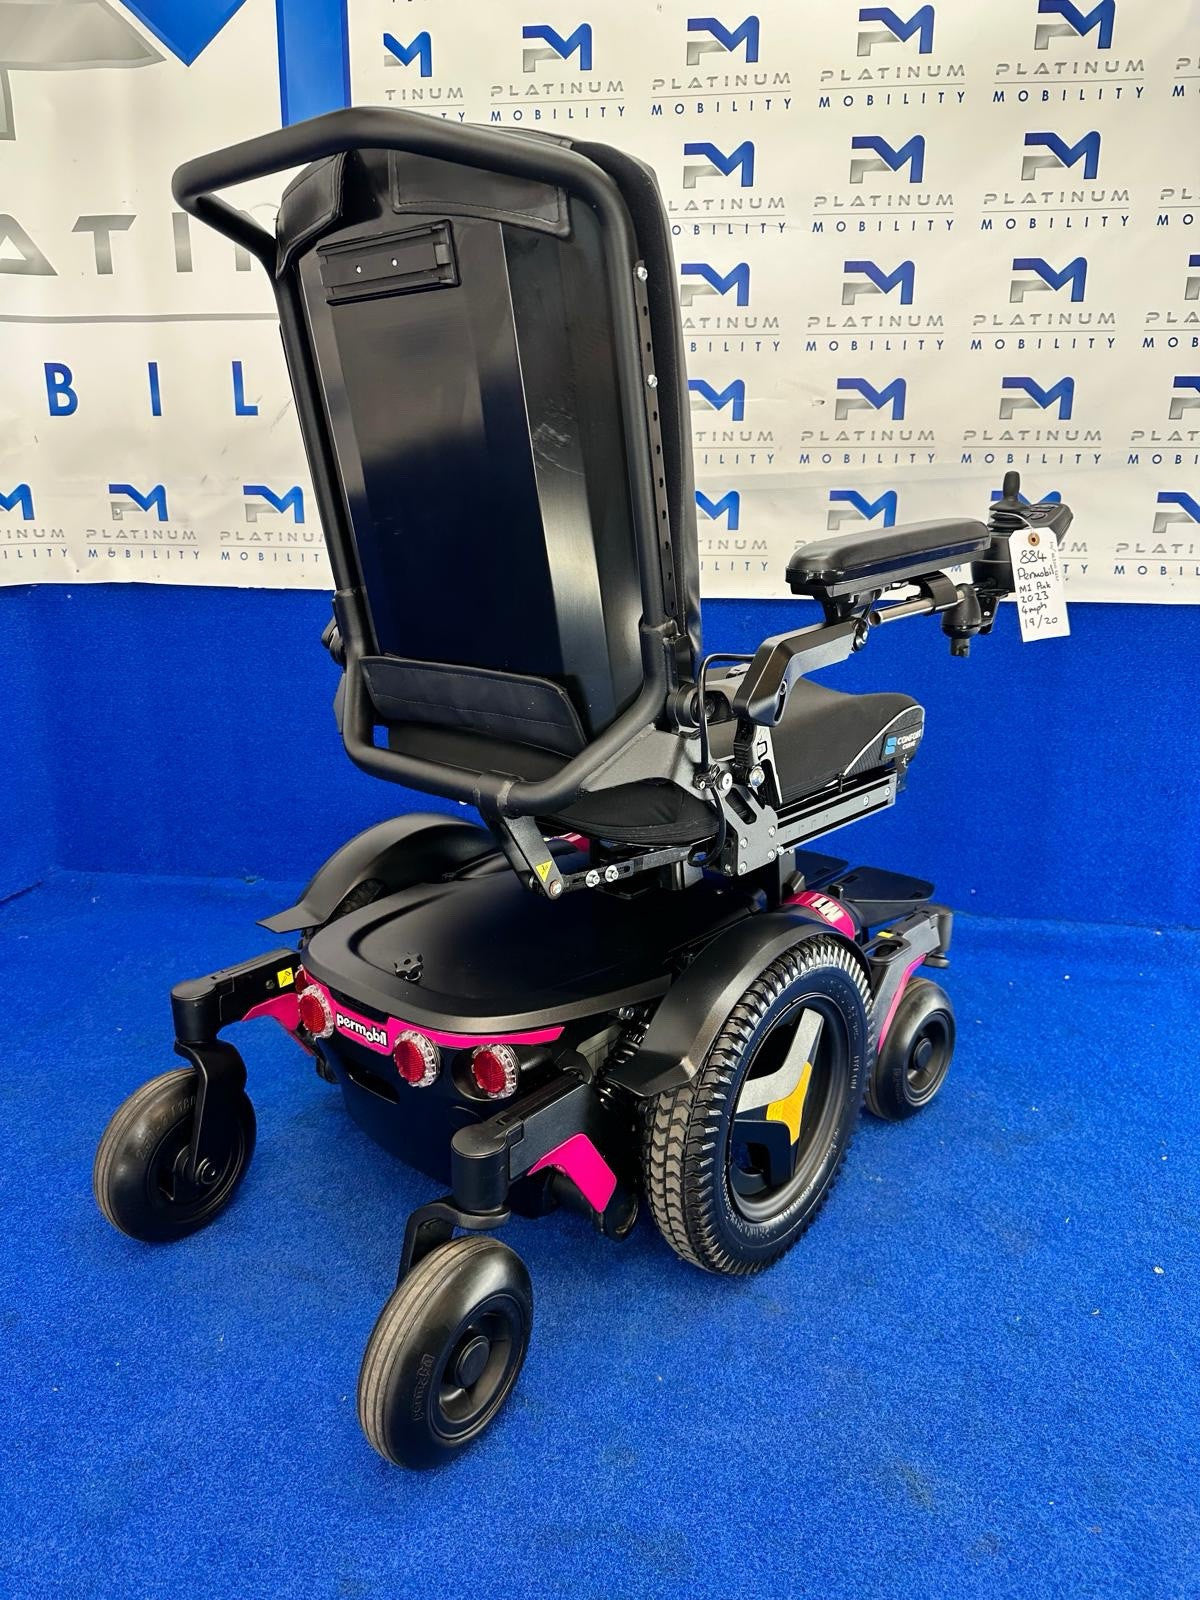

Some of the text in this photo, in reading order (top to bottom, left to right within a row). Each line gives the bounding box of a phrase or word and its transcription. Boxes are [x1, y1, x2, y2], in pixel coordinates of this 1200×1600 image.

[821, 65, 965, 82] PLATINUM
[996, 60, 1144, 75] PLATINUM
[652, 73, 790, 90] PLATINUM
[491, 81, 624, 97] PLATINUM
[993, 87, 1143, 102] MOBILITY
[819, 88, 966, 107] MOBILITY
[491, 103, 625, 121] MOBILITY
[651, 96, 791, 115] MOBILITY
[814, 194, 953, 207] PLATINUM
[984, 190, 1129, 204] PLATINUM
[812, 220, 953, 232] MOBILITY
[981, 212, 1128, 229] MOBILITY
[808, 315, 943, 327] PLATINUM
[973, 313, 1115, 325] PLATINUM
[806, 340, 943, 351] MOBILITY
[971, 338, 1115, 349] MOBILITY
[801, 431, 934, 441] PLATINUM
[964, 430, 1101, 440] PLATINUM
[800, 454, 935, 463] MOBILITY
[961, 454, 1101, 463] MOBILITY
[0, 529, 66, 538] INUM
[86, 530, 196, 539] PLATINUM
[219, 530, 324, 542] PLATINU
[699, 539, 768, 551] INUM
[89, 549, 199, 559] MOBILITY
[1020, 550, 1047, 564] 884
[1021, 591, 1049, 604] 2023
[1024, 615, 1058, 629] 19/20
[336, 1013, 387, 1046] permobil
